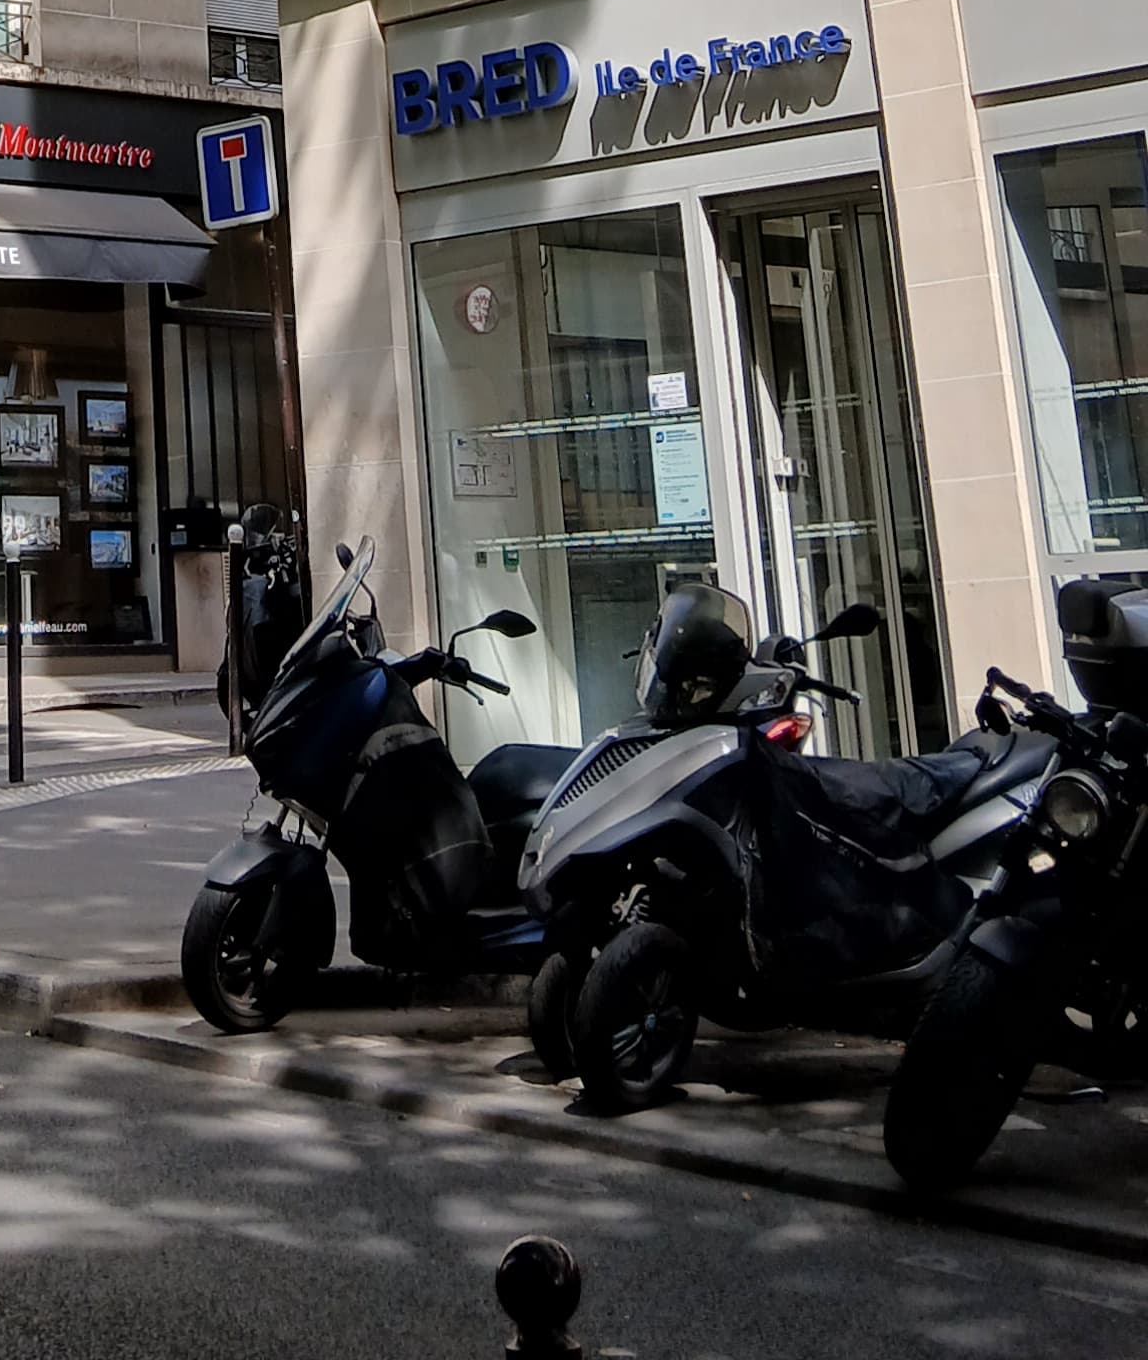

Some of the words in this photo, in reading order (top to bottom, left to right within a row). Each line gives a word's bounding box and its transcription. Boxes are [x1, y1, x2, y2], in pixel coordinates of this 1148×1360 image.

[392, 40, 574, 136] BRED
[595, 60, 642, 97] Ile
[649, 48, 699, 86] de
[707, 25, 846, 76] France
